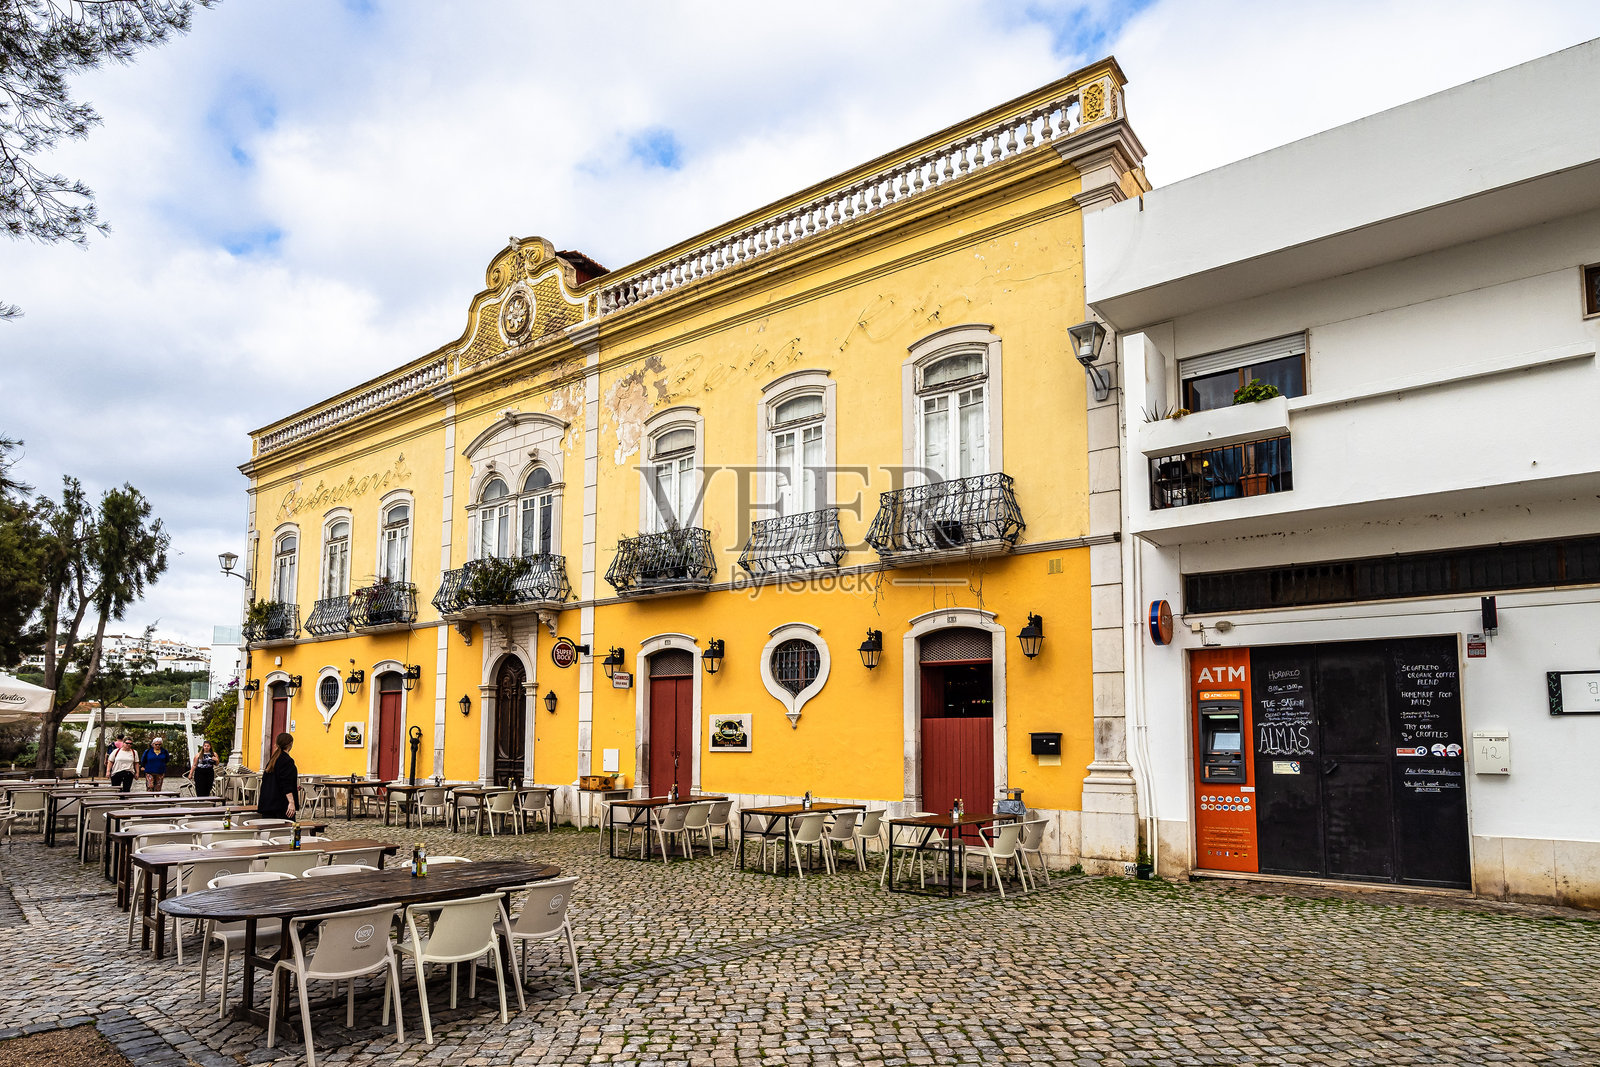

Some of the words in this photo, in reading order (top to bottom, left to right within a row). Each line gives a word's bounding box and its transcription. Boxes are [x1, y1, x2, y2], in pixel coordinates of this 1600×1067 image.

[556, 648, 572, 656] SUPER
[1198, 666, 1245, 683] ATM
[1258, 726, 1310, 750] ALMAS
[1481, 746, 1502, 760] 42
